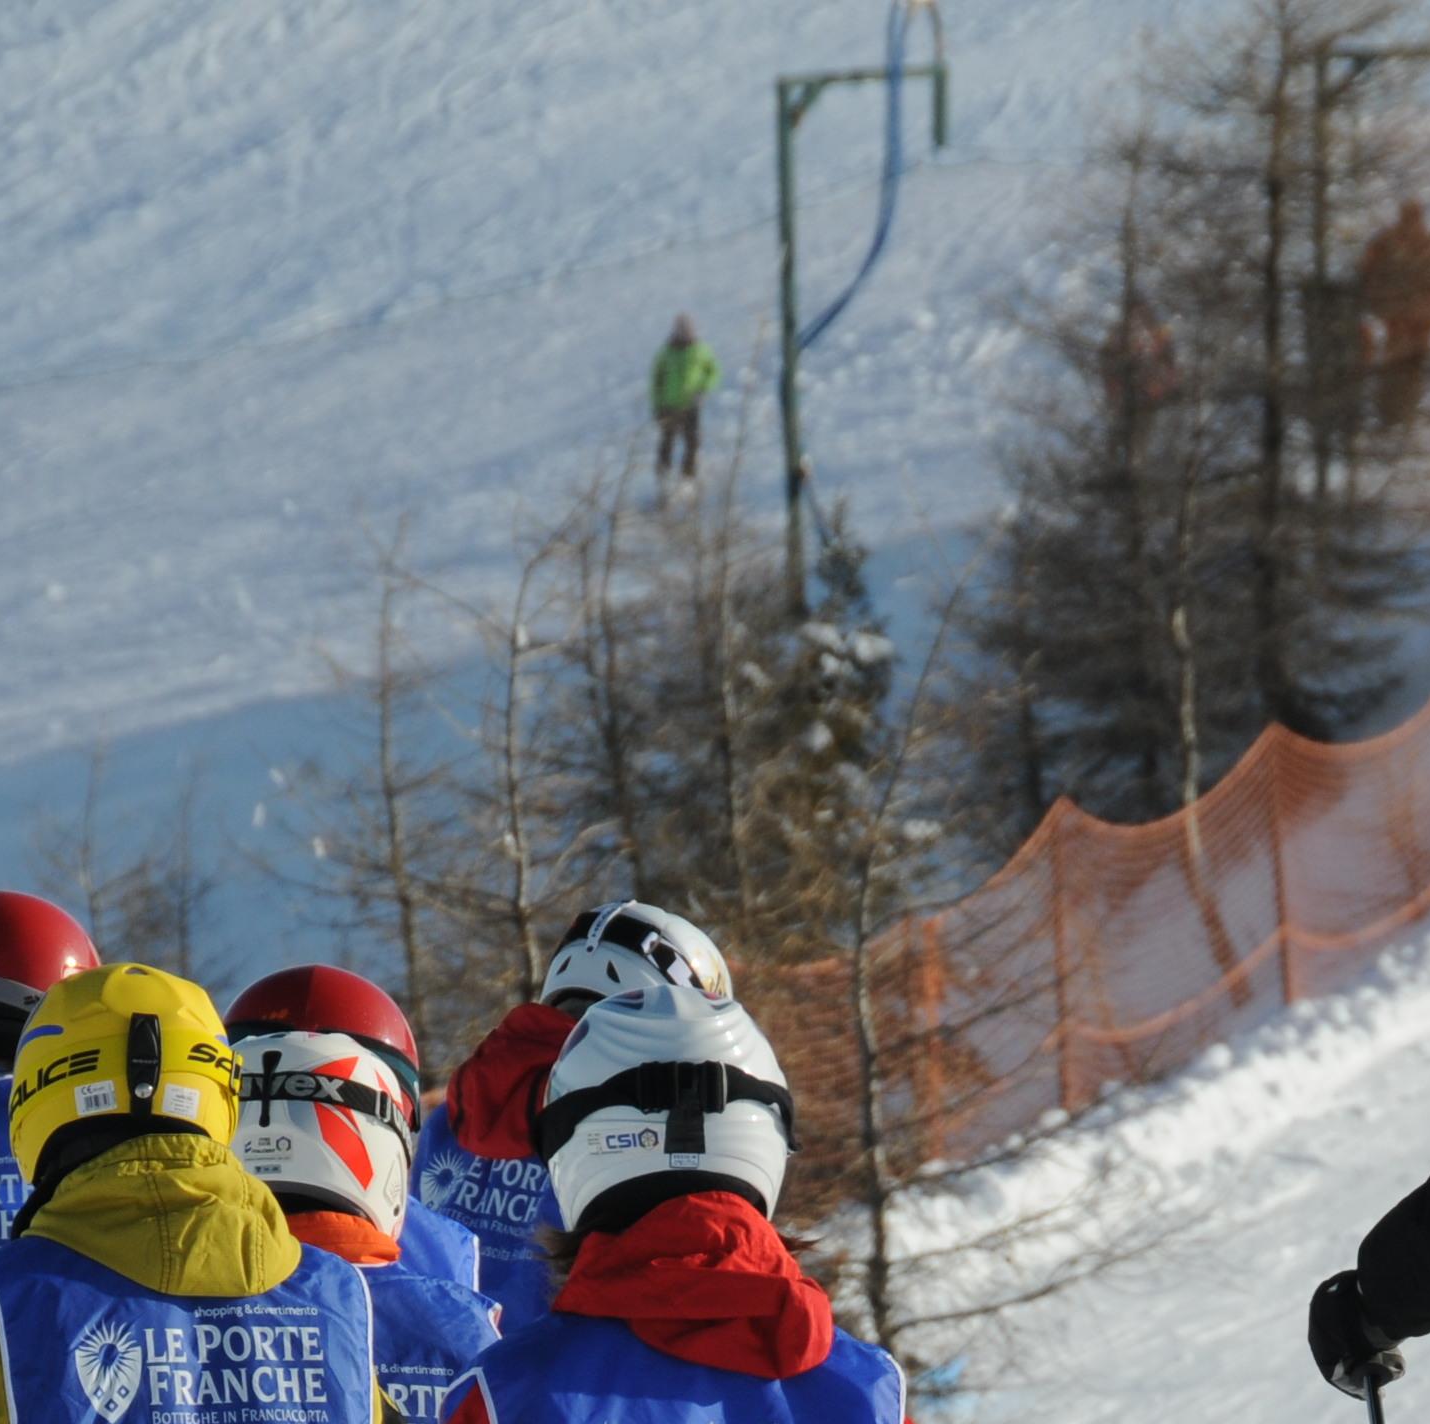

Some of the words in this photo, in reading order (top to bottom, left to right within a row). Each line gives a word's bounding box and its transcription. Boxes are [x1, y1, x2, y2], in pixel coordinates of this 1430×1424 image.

[195, 1303, 243, 1319] shopping
[245, 1304, 253, 1315] &
[254, 1303, 319, 1317] divertimento
[144, 1328, 188, 1363] LE
[193, 1324, 324, 1363] PORTE
[380, 1363, 389, 1374] &
[390, 1363, 455, 1377] divertimento
[147, 1366, 328, 1406] FRANCHE
[152, 1411, 220, 1424] BOTTEGHE
[223, 1411, 237, 1424] IN
[242, 1408, 329, 1424] FRANCIACORTA
